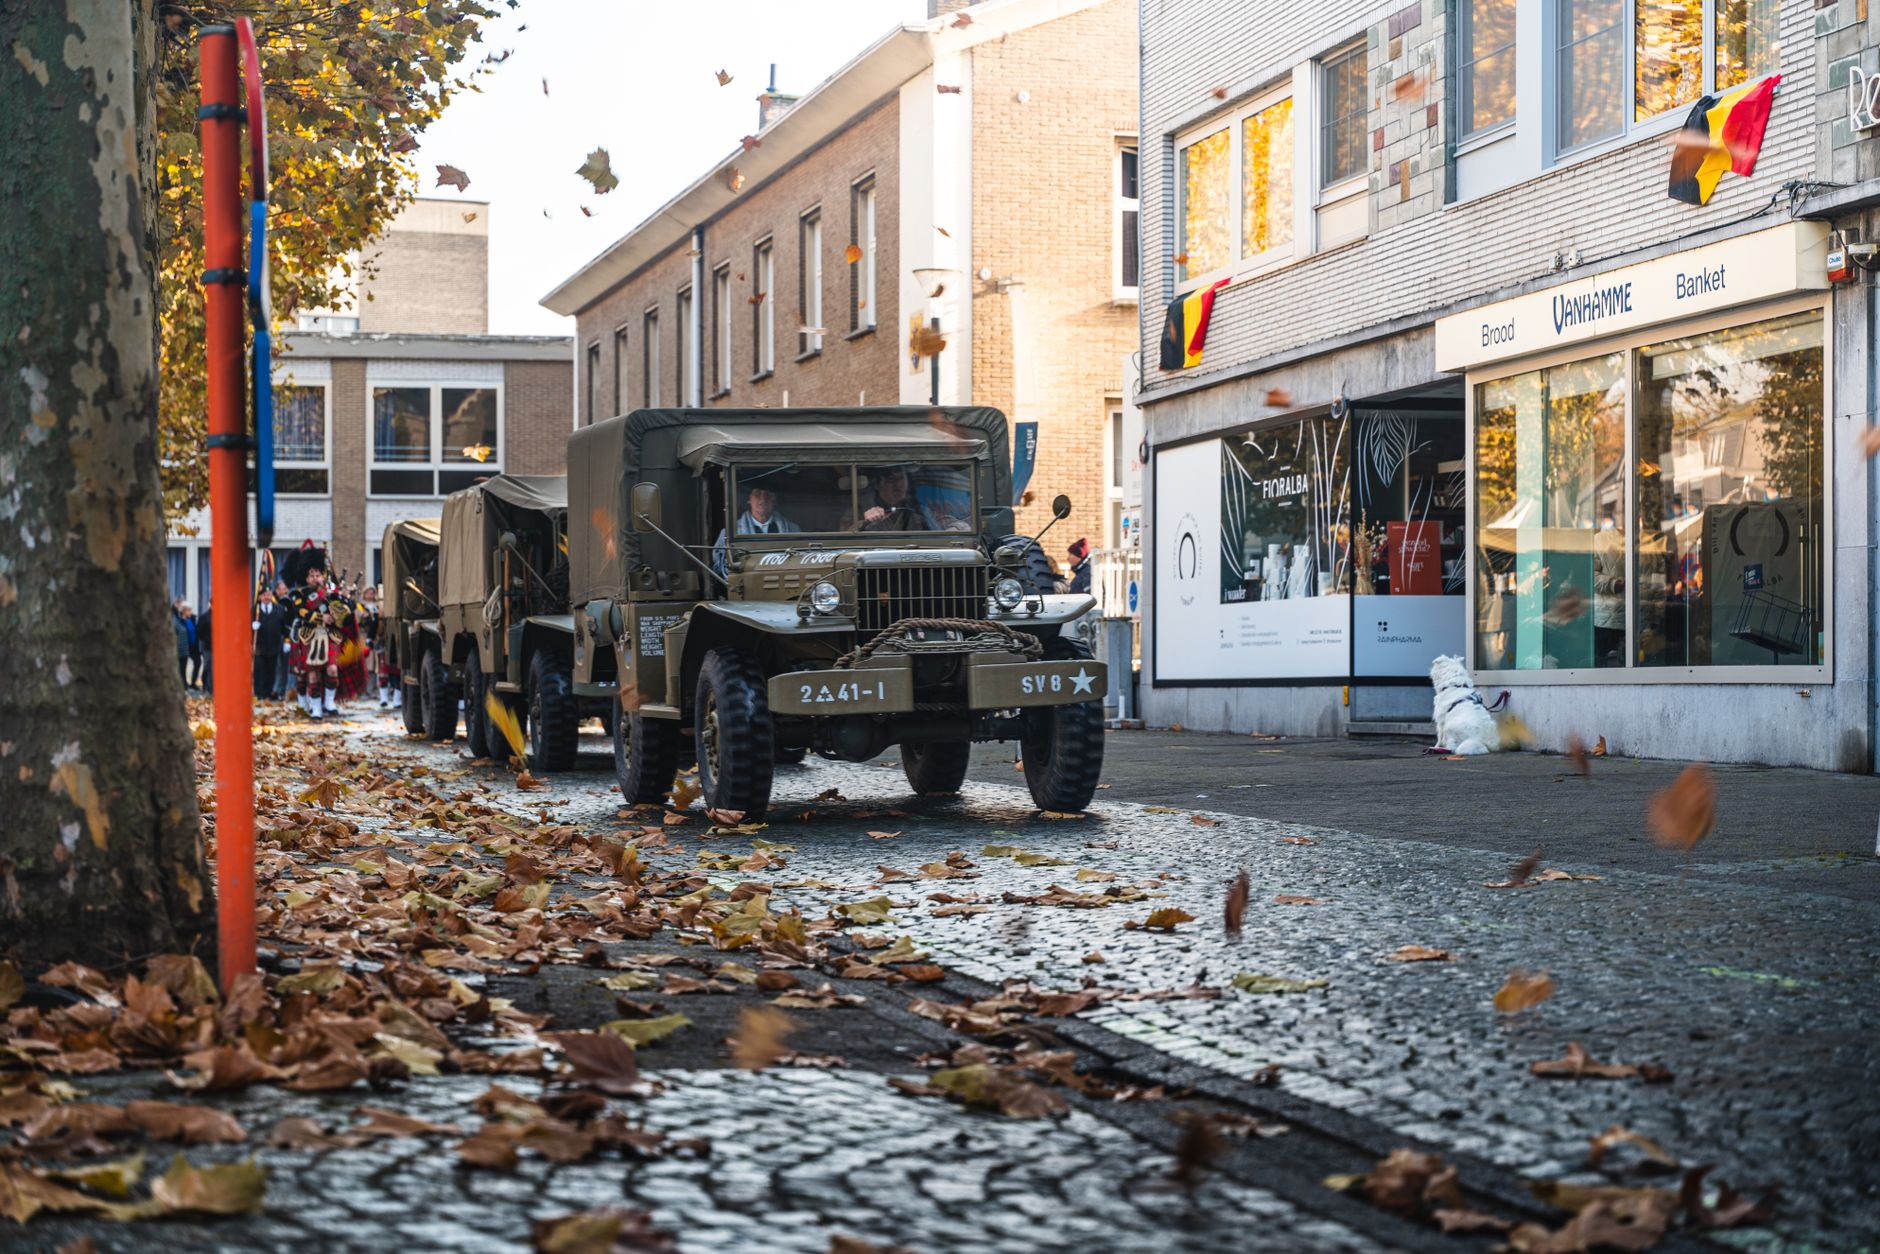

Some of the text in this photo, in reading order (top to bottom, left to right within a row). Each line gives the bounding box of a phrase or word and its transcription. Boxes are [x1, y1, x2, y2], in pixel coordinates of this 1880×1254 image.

[1482, 263, 1726, 348] Brood VANHAMME Banket
[1263, 473, 1309, 500] FIORALBA
